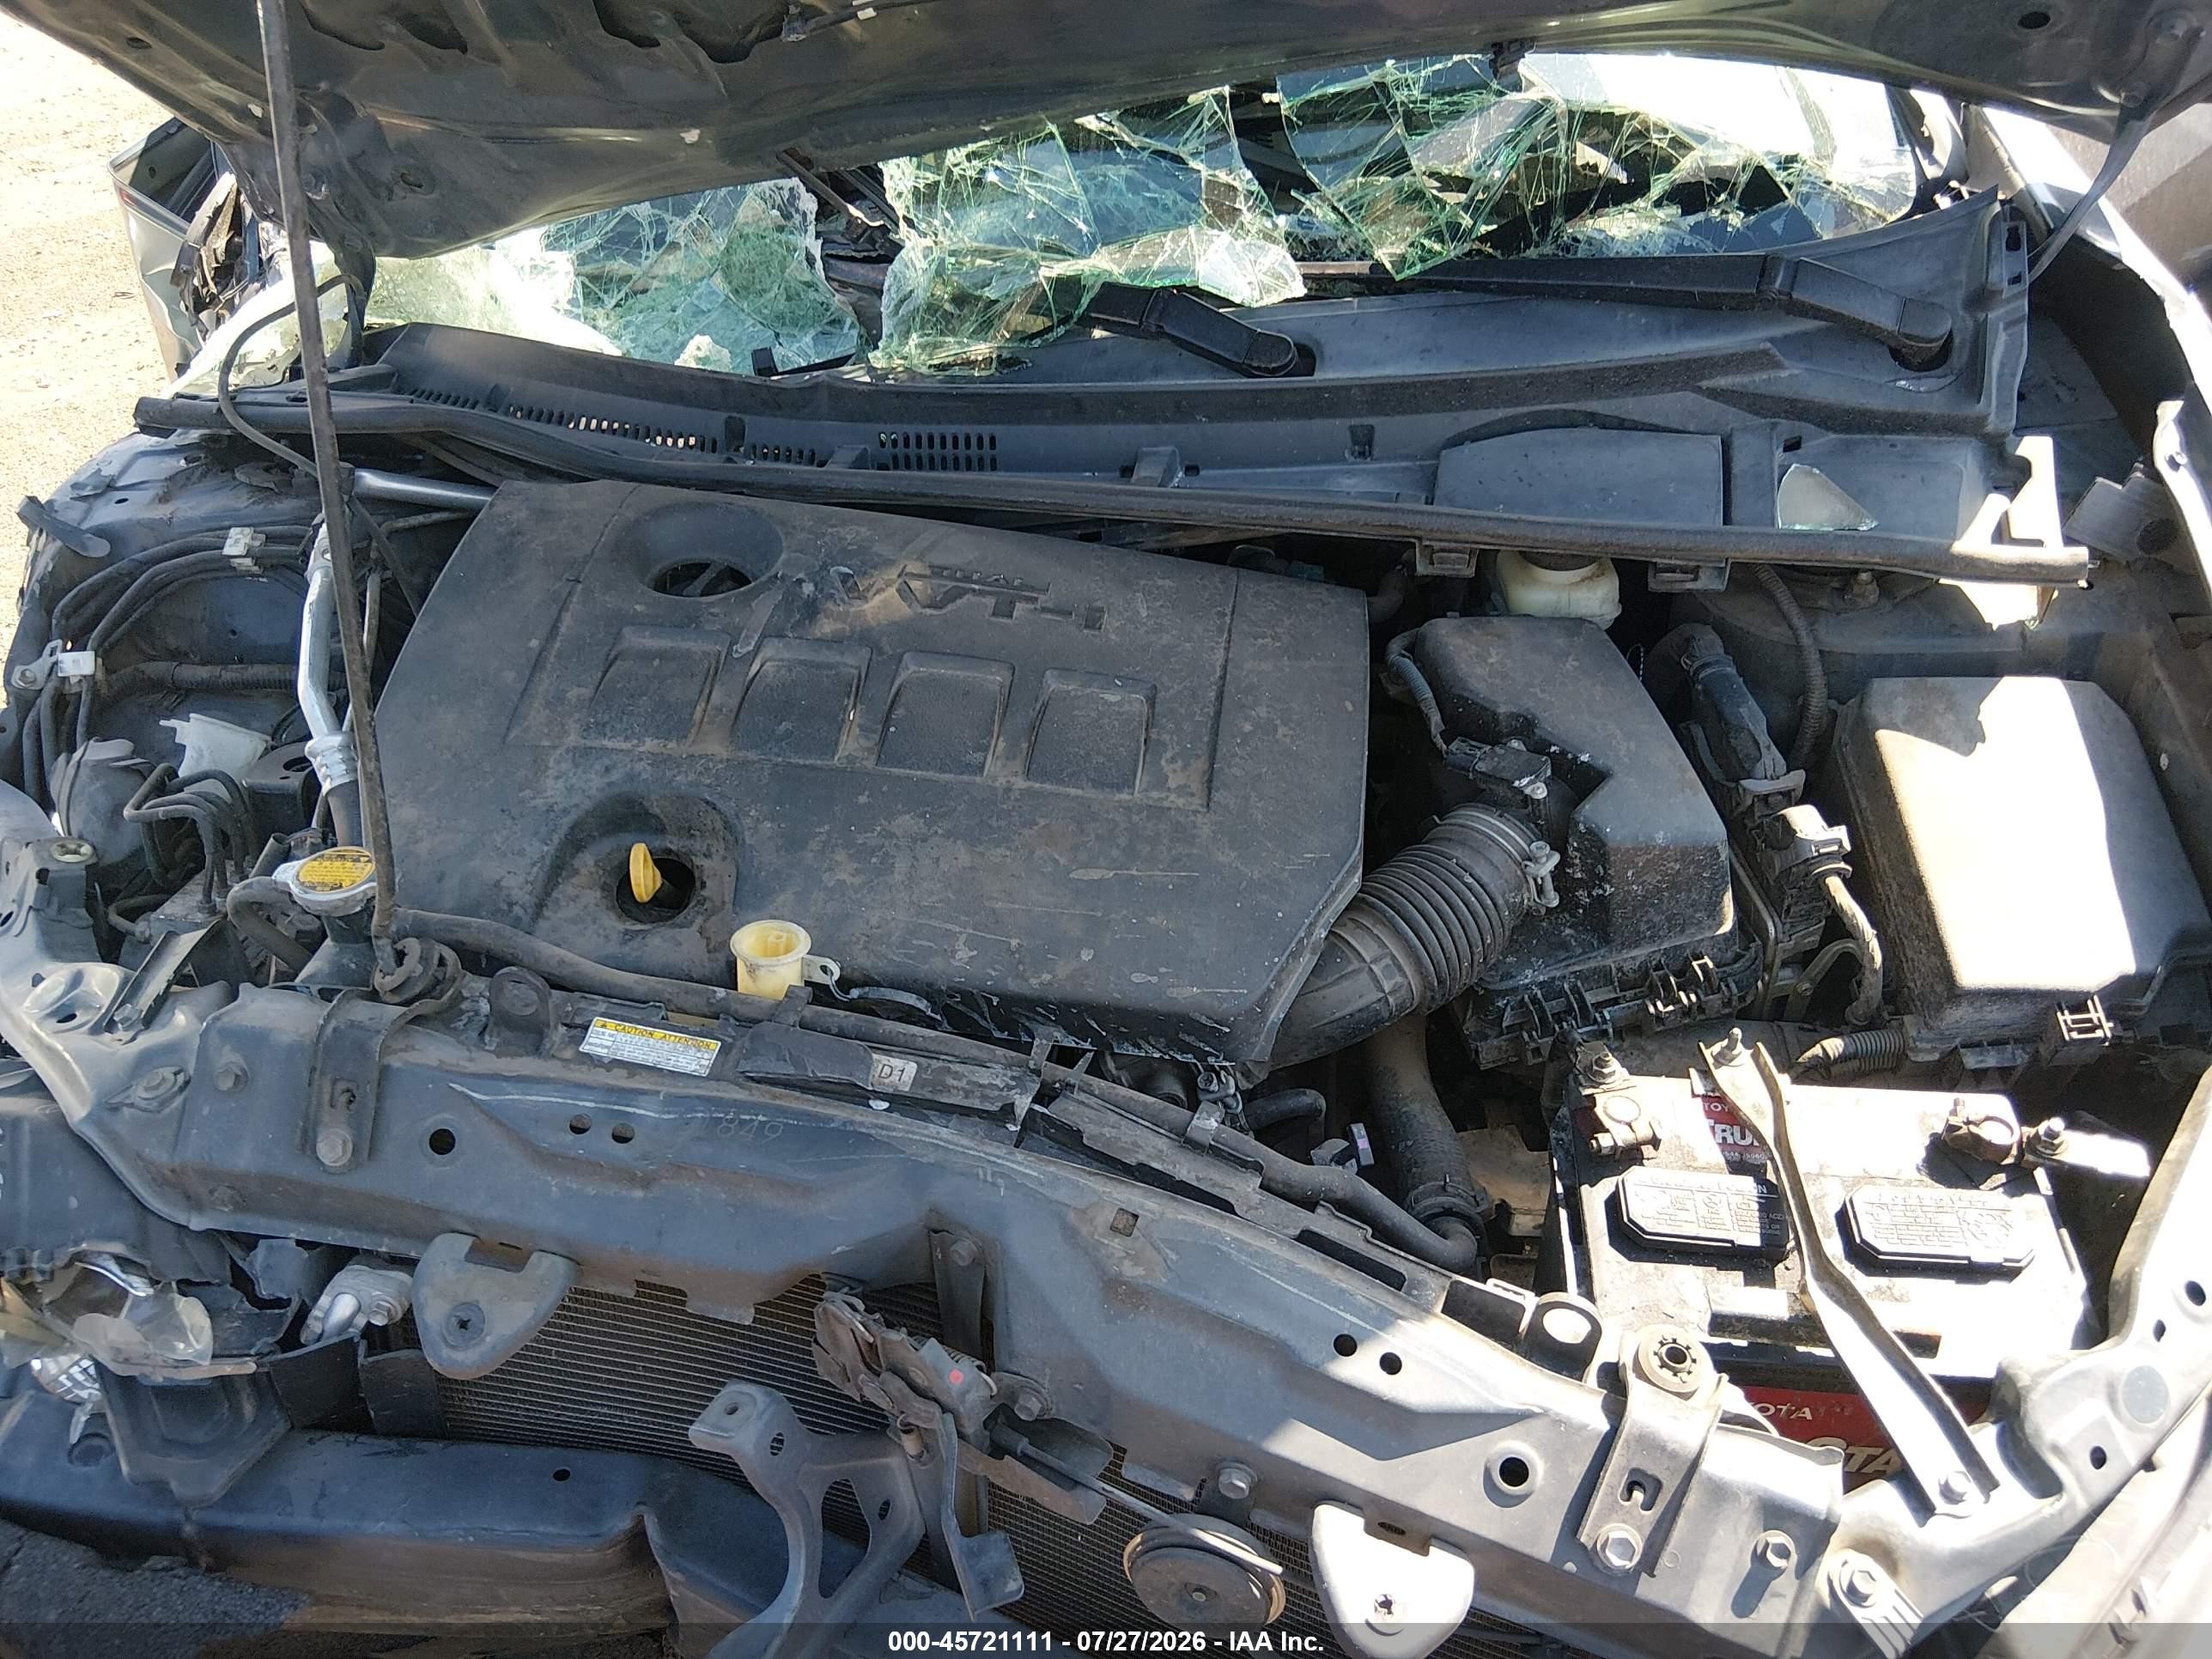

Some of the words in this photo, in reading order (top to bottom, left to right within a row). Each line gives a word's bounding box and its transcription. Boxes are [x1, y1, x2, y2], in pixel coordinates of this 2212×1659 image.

[615, 1024, 653, 1037] CAUTION
[660, 1033, 711, 1049] ATTENTION
[878, 1064, 906, 1082] D1
[1705, 1119, 1759, 1146] RU
[1749, 1401, 1813, 1420] OTA
